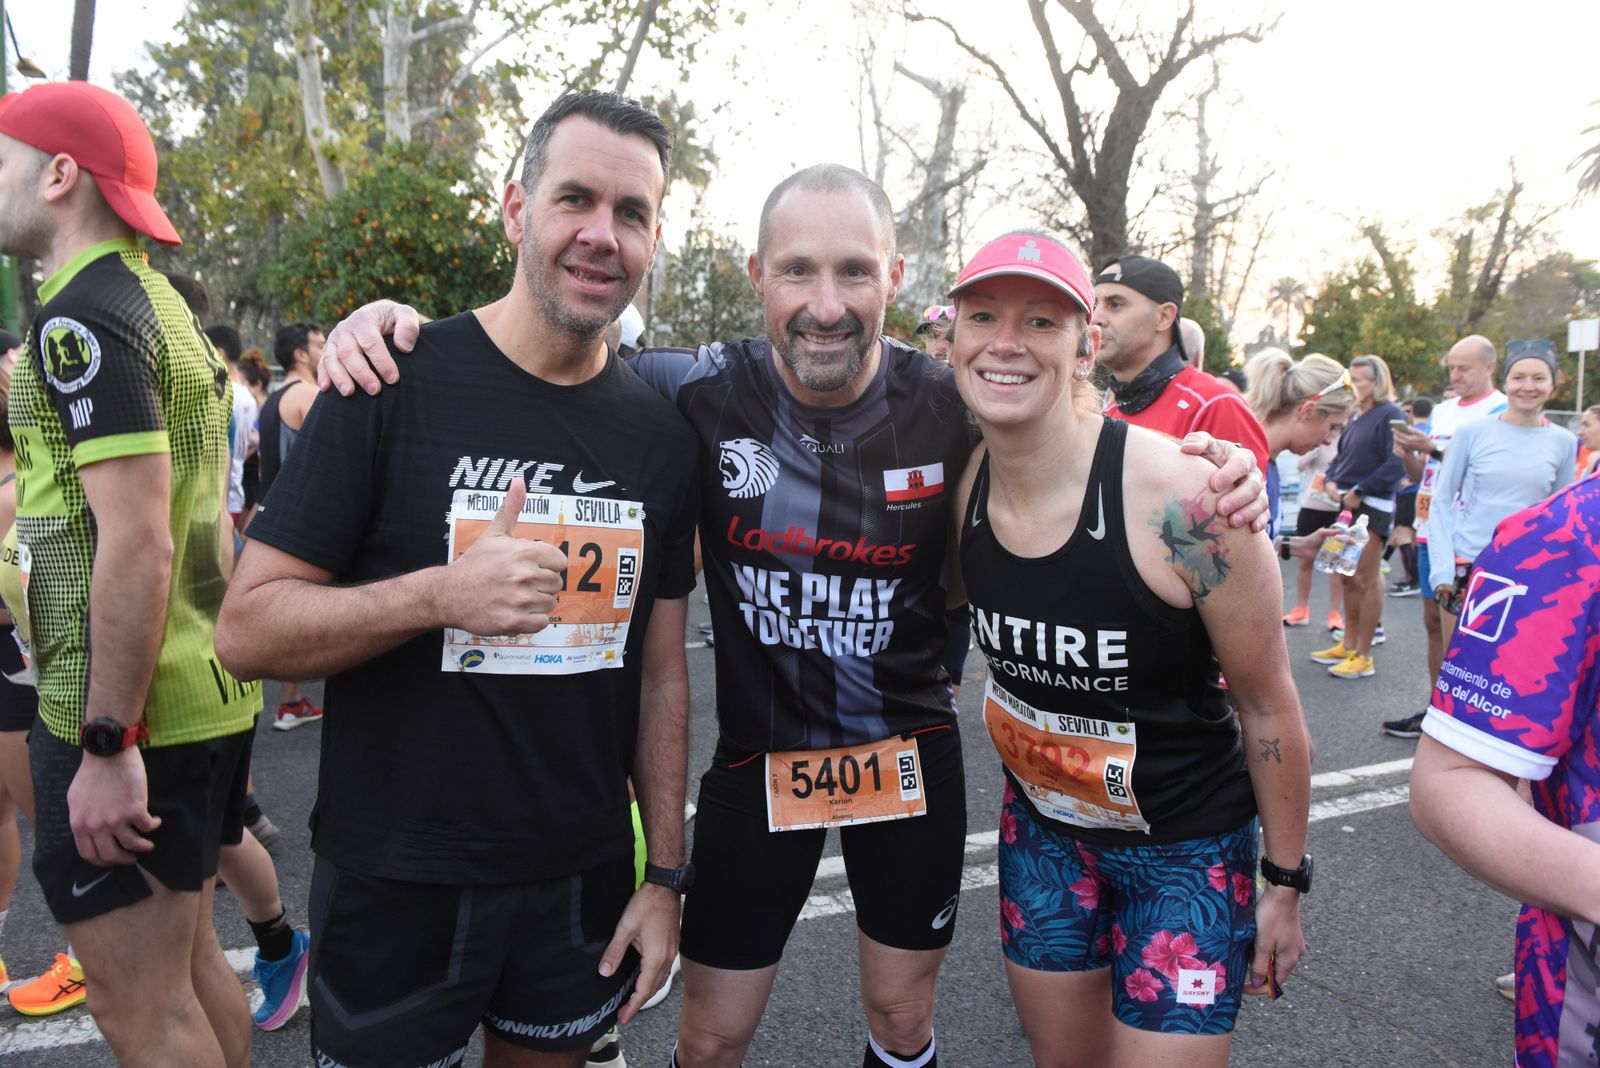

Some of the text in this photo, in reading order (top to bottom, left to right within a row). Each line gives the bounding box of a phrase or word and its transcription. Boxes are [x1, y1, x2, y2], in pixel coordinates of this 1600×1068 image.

[449, 456, 564, 494] NIKE
[467, 494, 621, 524] MEDIO ATÓN SEVILLA
[886, 502, 922, 512] Hercules
[727, 515, 917, 566] Ladbrokes
[730, 561, 903, 620] WE PLAY
[739, 603, 895, 658] TOGETHER
[534, 654, 564, 664] HOKA
[985, 655, 1129, 692] FORMANCE
[992, 682, 1008, 703] MEDIO
[1058, 715, 1109, 738] SEVILLA
[1436, 675, 1512, 719] iso del Alcor
[1491, 682, 1512, 699] de
[791, 752, 882, 799] 5401
